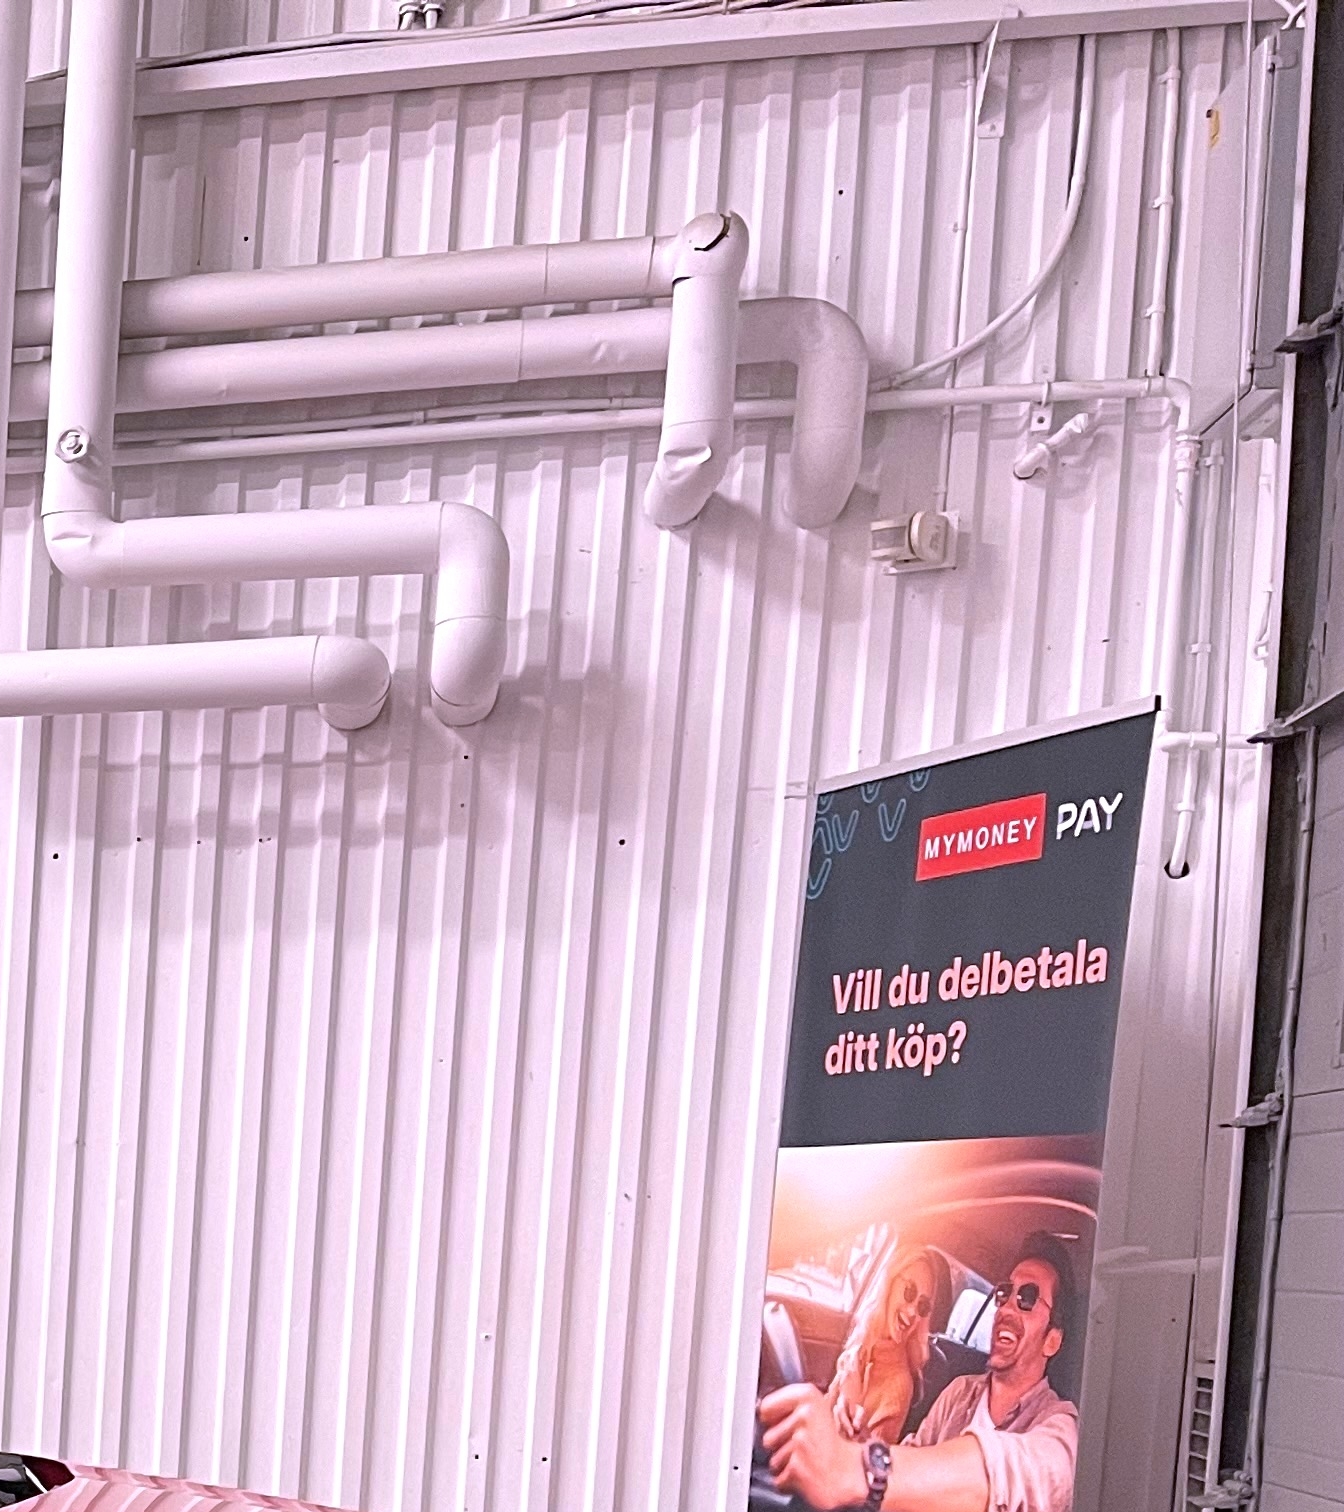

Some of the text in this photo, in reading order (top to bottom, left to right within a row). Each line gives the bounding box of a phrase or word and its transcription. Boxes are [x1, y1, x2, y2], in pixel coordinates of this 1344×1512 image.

[924, 792, 1124, 861] MYMONEY PAY
[831, 939, 1109, 1015] Vill du delbetala
[824, 1020, 968, 1077] ditt köp?
